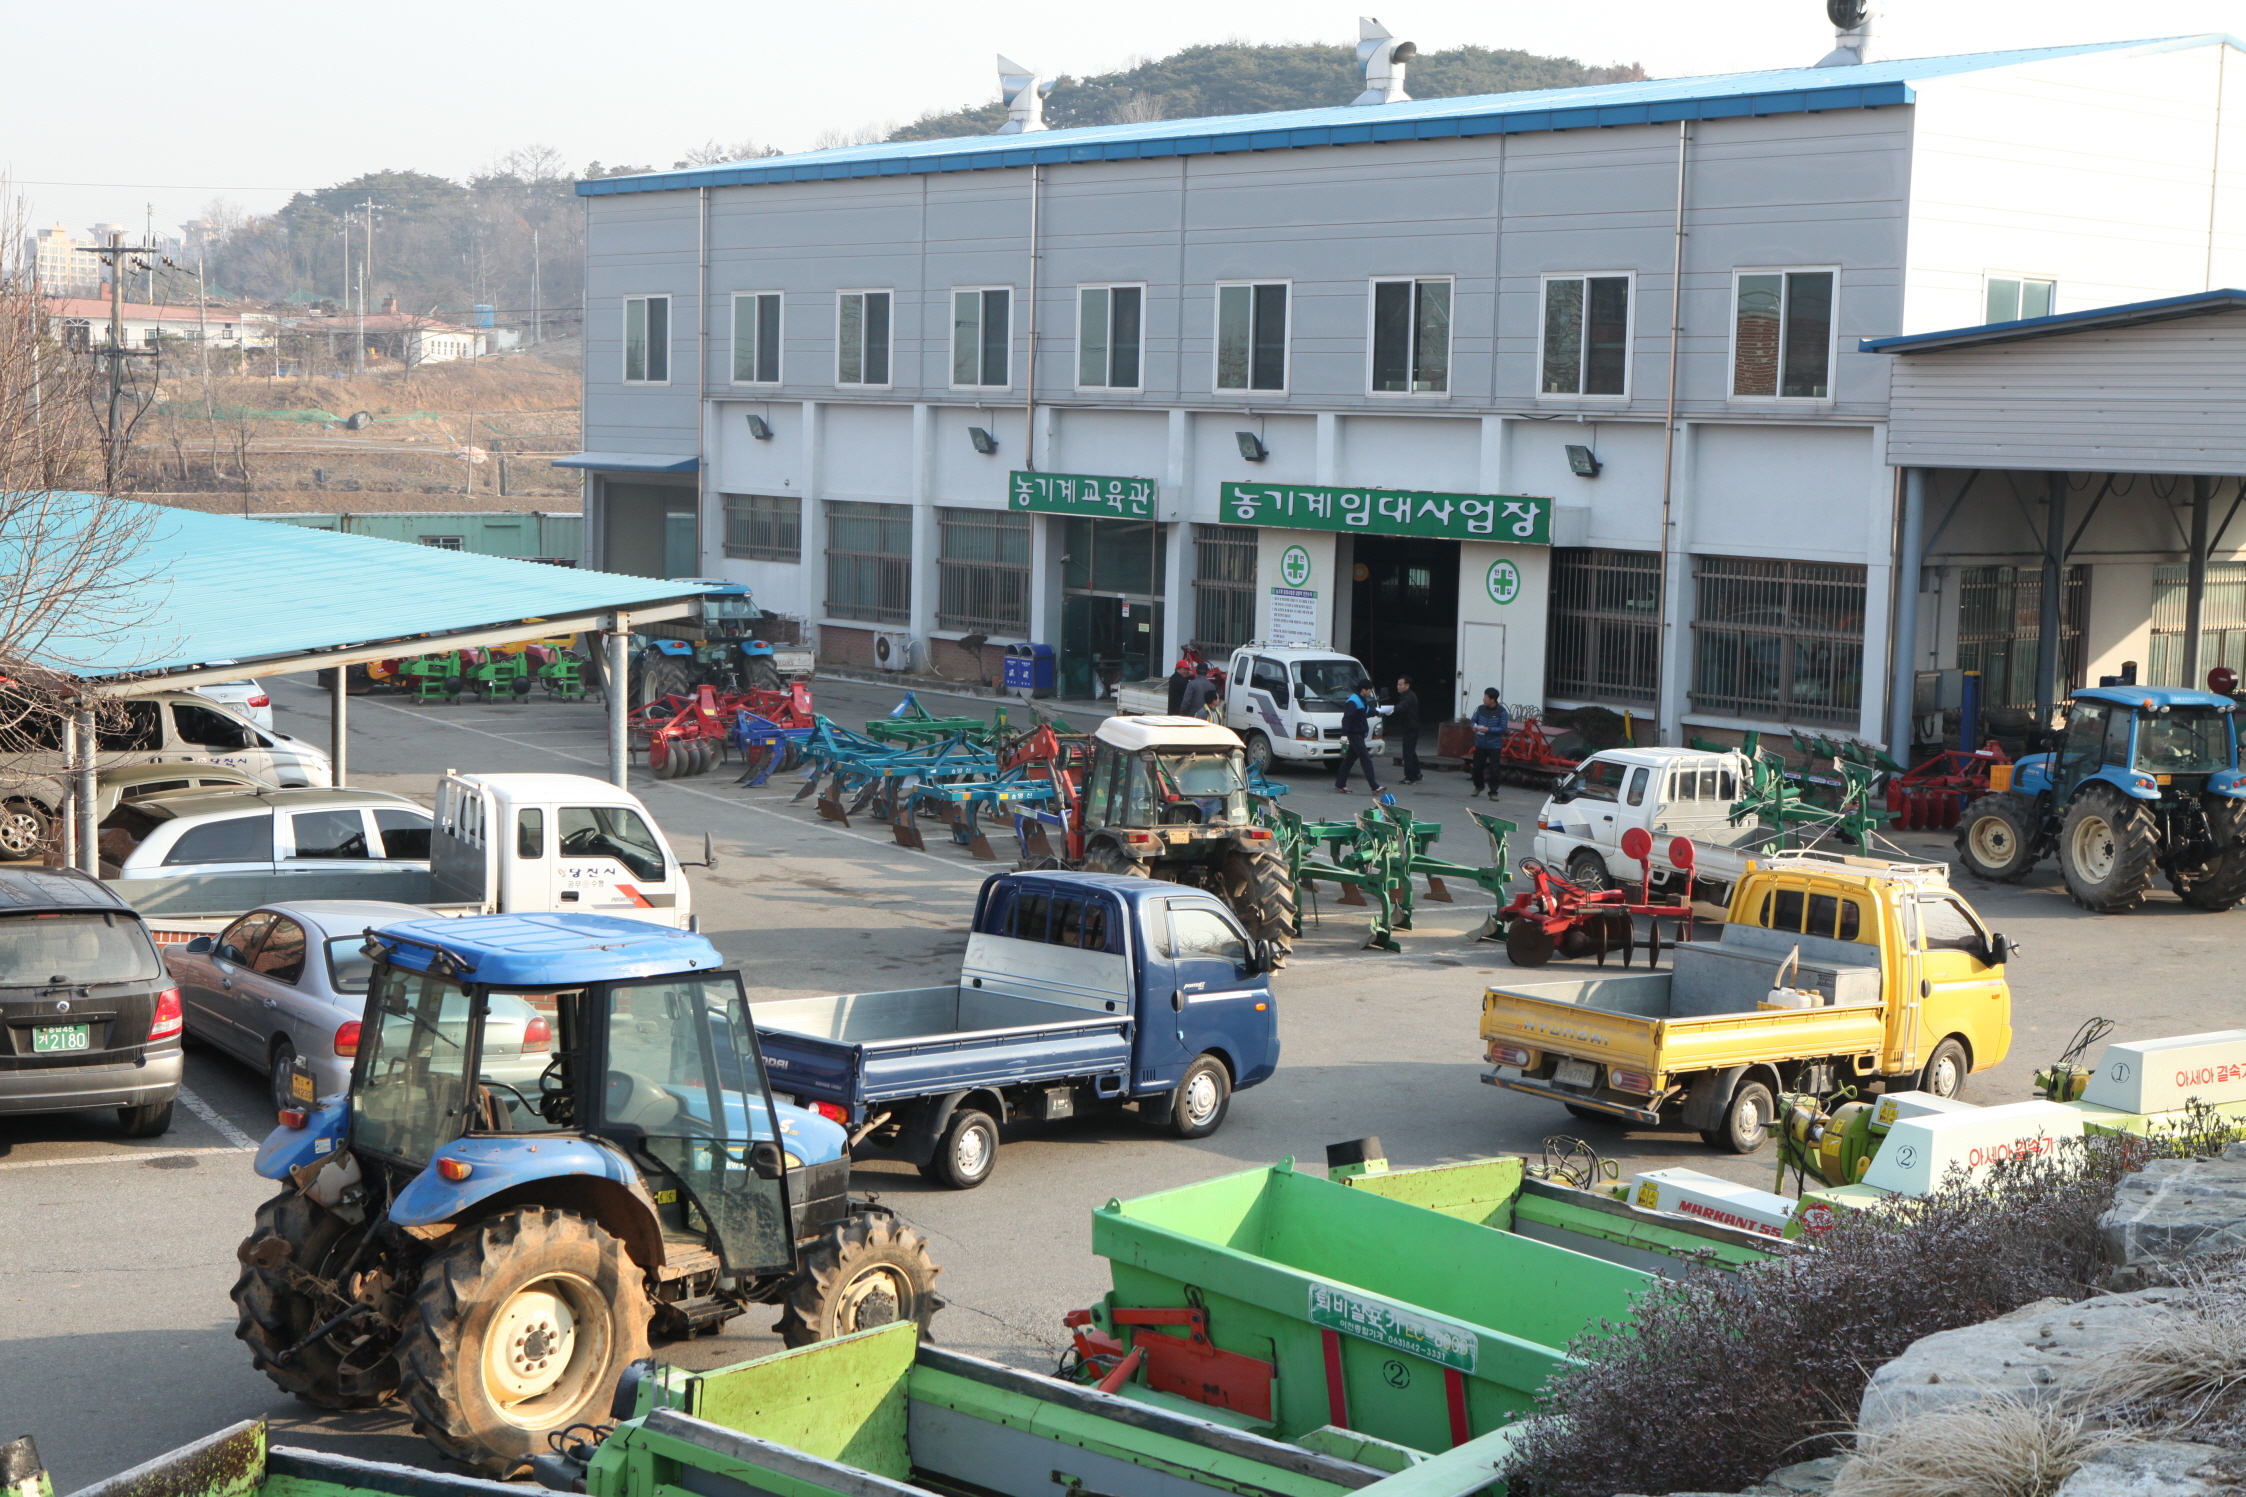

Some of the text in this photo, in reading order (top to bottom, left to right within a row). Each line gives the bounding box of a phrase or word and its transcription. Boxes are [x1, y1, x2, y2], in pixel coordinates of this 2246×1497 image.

[1231, 487, 1541, 538] 농기계임대사업장
[569, 868, 616, 878] 당진시
[1524, 1019, 1609, 1046] HYUNDAI
[2175, 1067, 2214, 1088] 아세아
[1678, 1200, 1784, 1238] MARKANT 55
